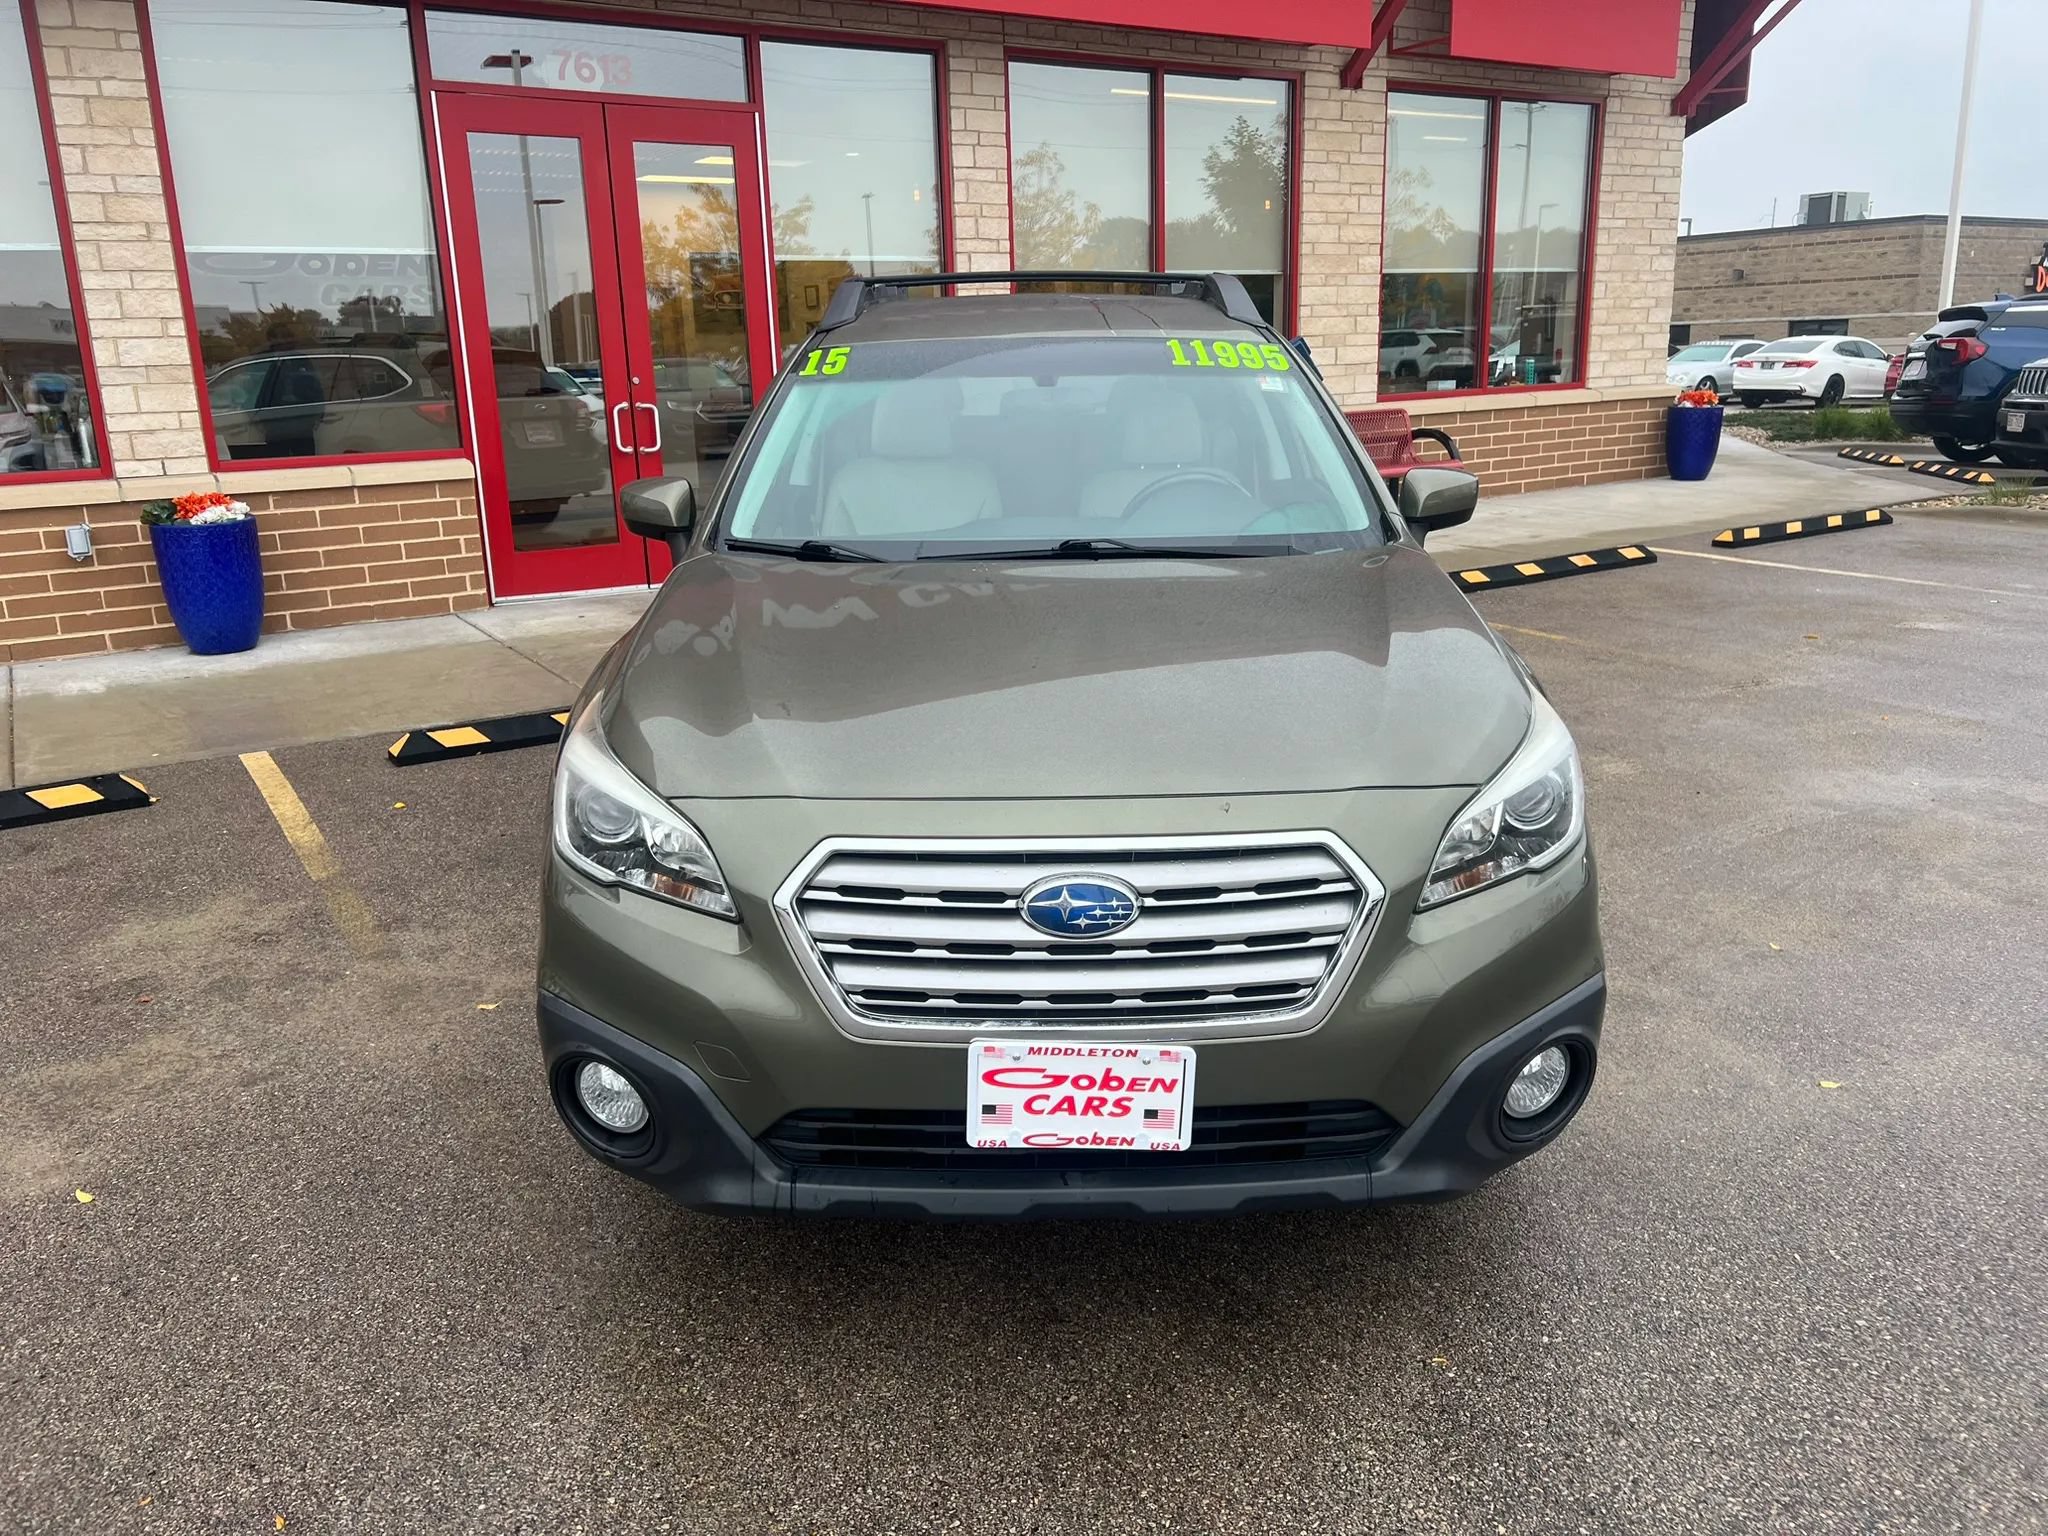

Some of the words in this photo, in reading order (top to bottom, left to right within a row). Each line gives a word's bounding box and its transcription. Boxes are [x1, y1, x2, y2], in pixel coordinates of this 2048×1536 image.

[552, 49, 632, 84] 7613
[322, 283, 433, 306] CARS
[799, 347, 851, 376] 15
[1166, 339, 1290, 371] 11995
[1027, 1046, 1138, 1058] MIDDLETON
[1023, 1094, 1135, 1117] CARS
[977, 1140, 1008, 1148] USA
[1150, 1142, 1181, 1151] USA
